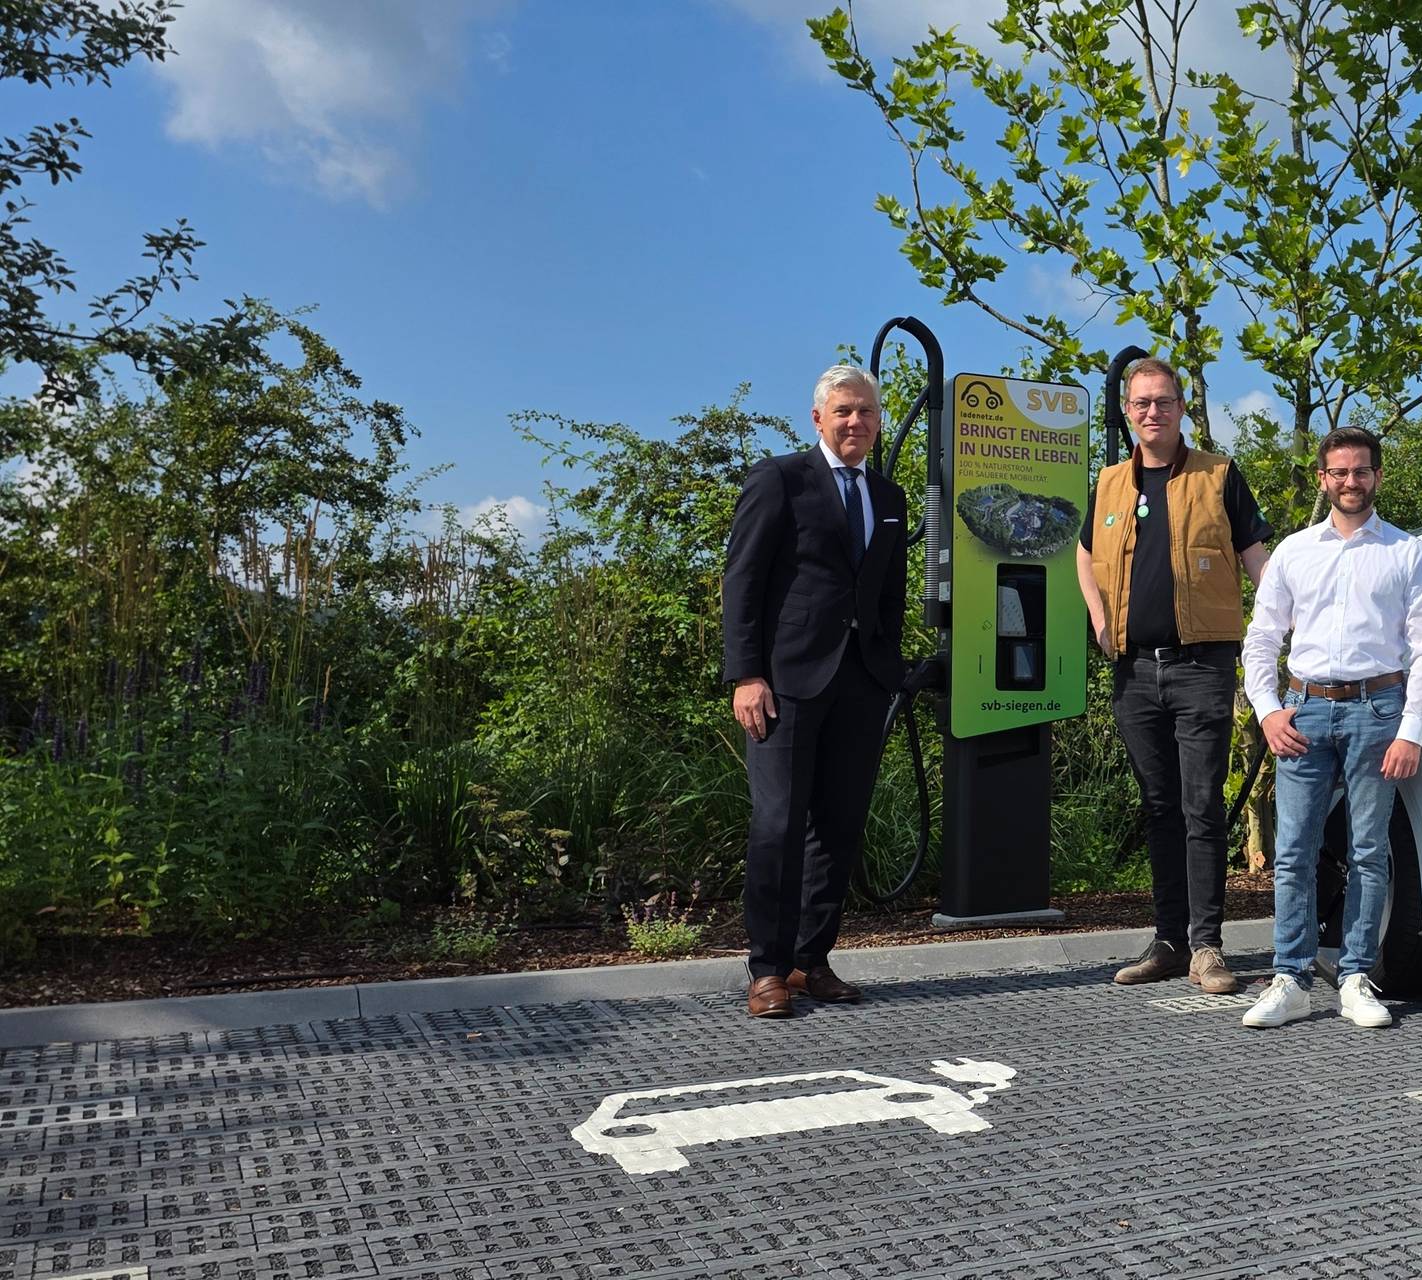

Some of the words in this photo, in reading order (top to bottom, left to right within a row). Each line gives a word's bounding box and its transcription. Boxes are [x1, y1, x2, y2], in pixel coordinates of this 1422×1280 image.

[1027, 388, 1084, 416] SVB.
[960, 411, 1004, 422] ladenetz.de
[960, 422, 1017, 441] BRINGT
[1021, 429, 1082, 447] ENERGIE
[960, 441, 976, 456] IN
[981, 443, 1031, 461] UNSER
[1035, 447, 1083, 465] LEBEN.
[960, 460, 973, 468] 100
[983, 463, 1033, 473] NATURSTROM
[959, 469, 974, 477] FÜR
[975, 471, 1009, 481] SAUBERE
[981, 700, 1061, 713] svb-siegen.de
